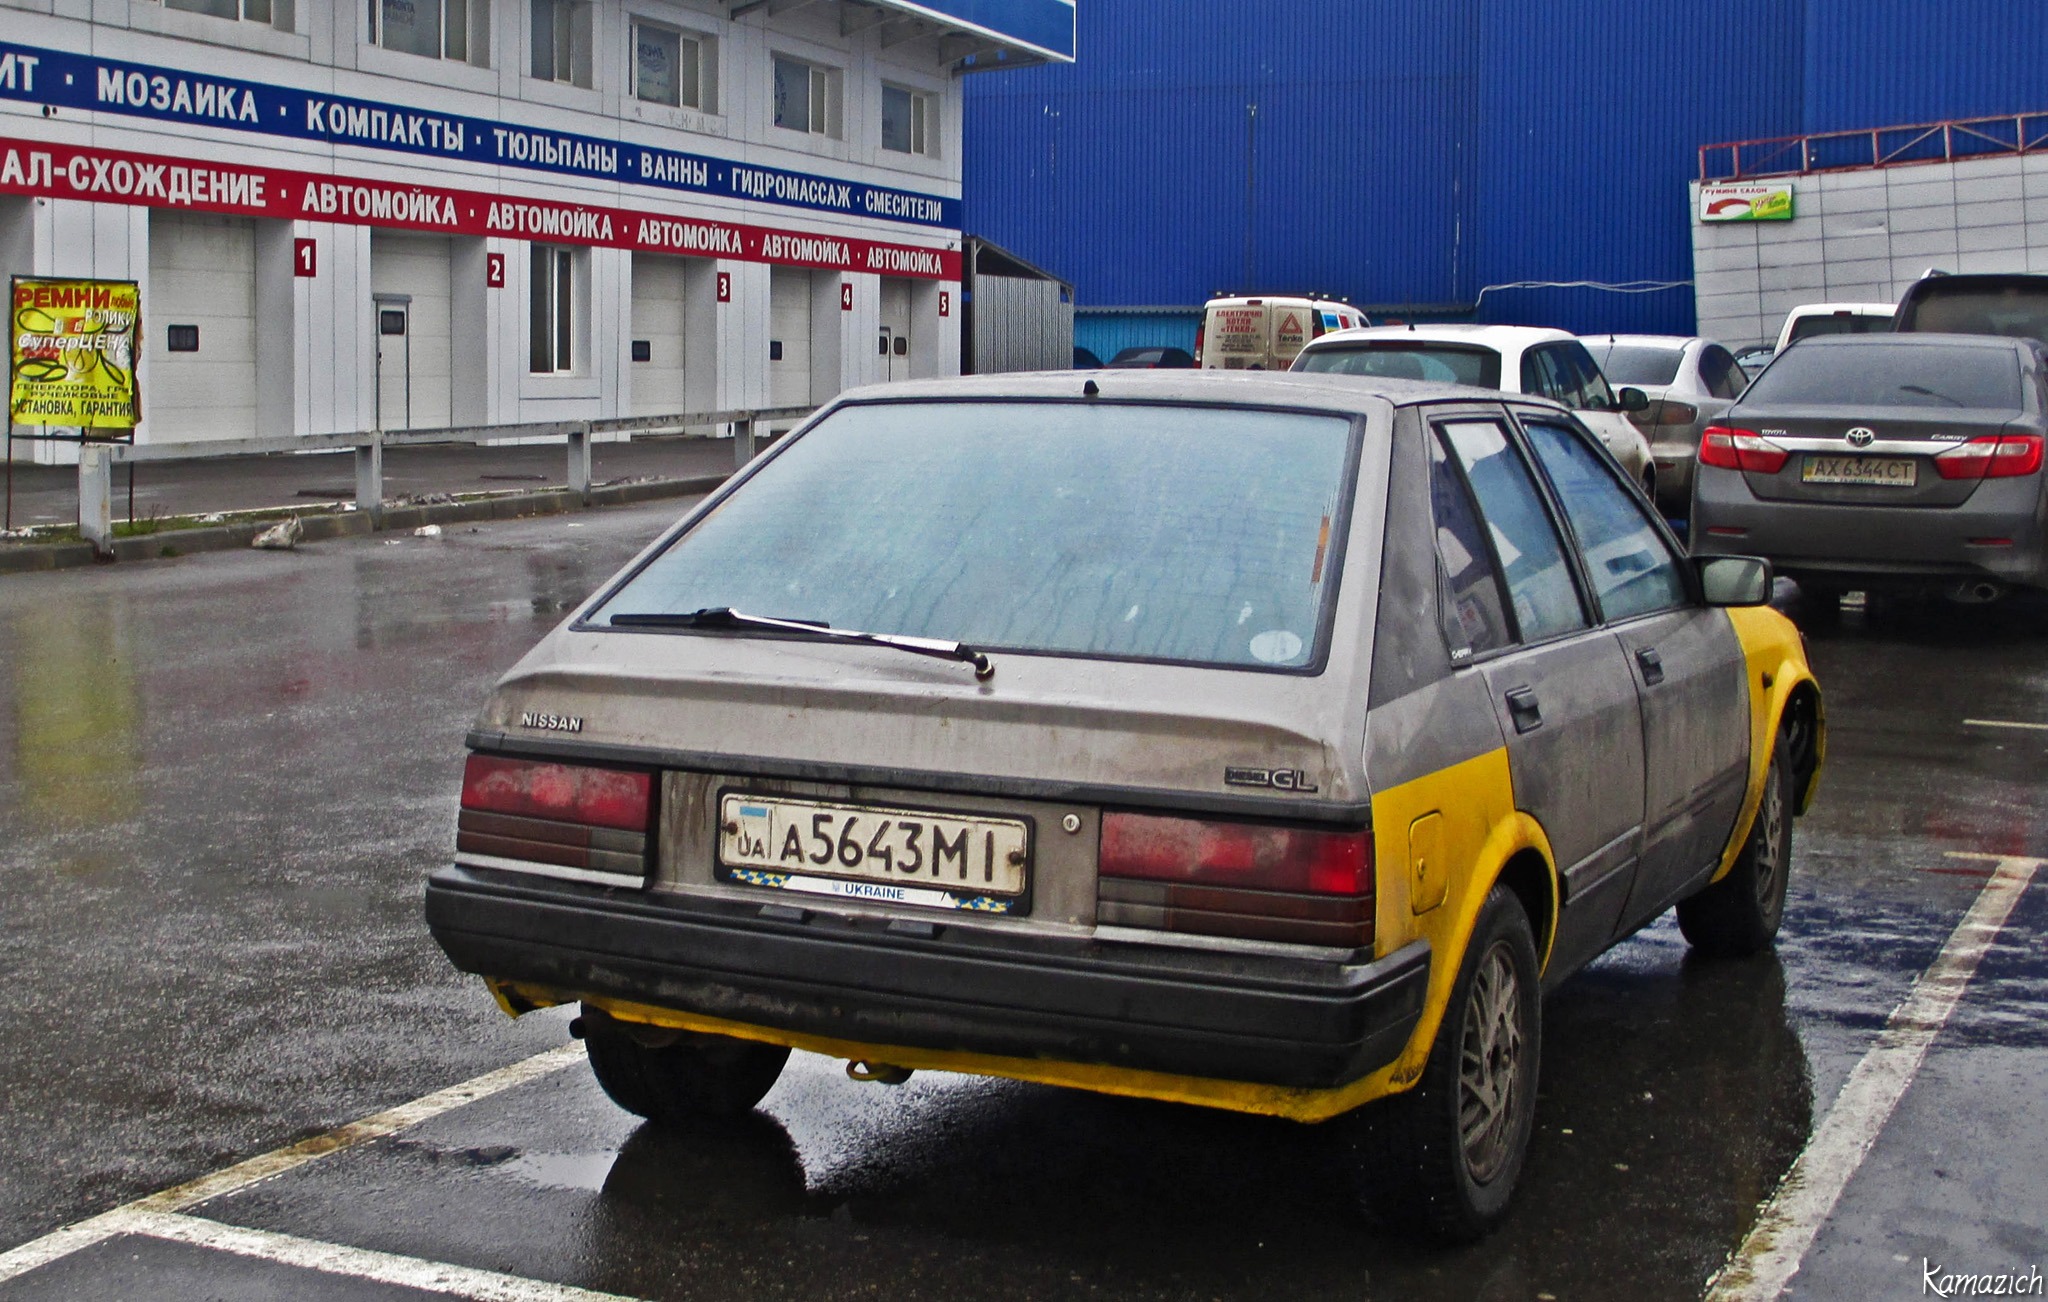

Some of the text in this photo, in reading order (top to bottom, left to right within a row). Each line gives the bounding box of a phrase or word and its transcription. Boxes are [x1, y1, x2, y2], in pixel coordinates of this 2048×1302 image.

[97, 66, 259, 123] МОЗАИКА
[306, 99, 464, 152] КОМПАКТЫ
[493, 128, 618, 174] ТЮЛЬПАНЫ
[640, 152, 708, 187] ВАННЫ
[732, 167, 851, 209] ГИДРОМАССАЖ
[865, 190, 942, 222] СМЕСИТЕЛИ
[1, 149, 943, 275] АЛ-СХОЖДЕНИЕ АВТОМОЙКА АВТОМОЙКА АВТОМОЙКА АВТОМОЙКА АВТОМОЙКА
[301, 245, 311, 270] 1
[491, 259, 501, 282] 2
[16, 287, 111, 308] РЕМНИ
[720, 278, 728, 297] 3
[843, 288, 851, 306] 4
[940, 296, 947, 312] 5
[15, 399, 133, 418] УСТАНОВКА, ГАРАНТИЯ
[1761, 428, 1787, 436] TOYOTA
[1814, 459, 1839, 476] AX
[1887, 462, 1913, 479] CT
[522, 712, 582, 732] NISSAN
[1272, 769, 1317, 791] GL
[737, 836, 765, 859] UA
[844, 883, 905, 899] UKRAINE
